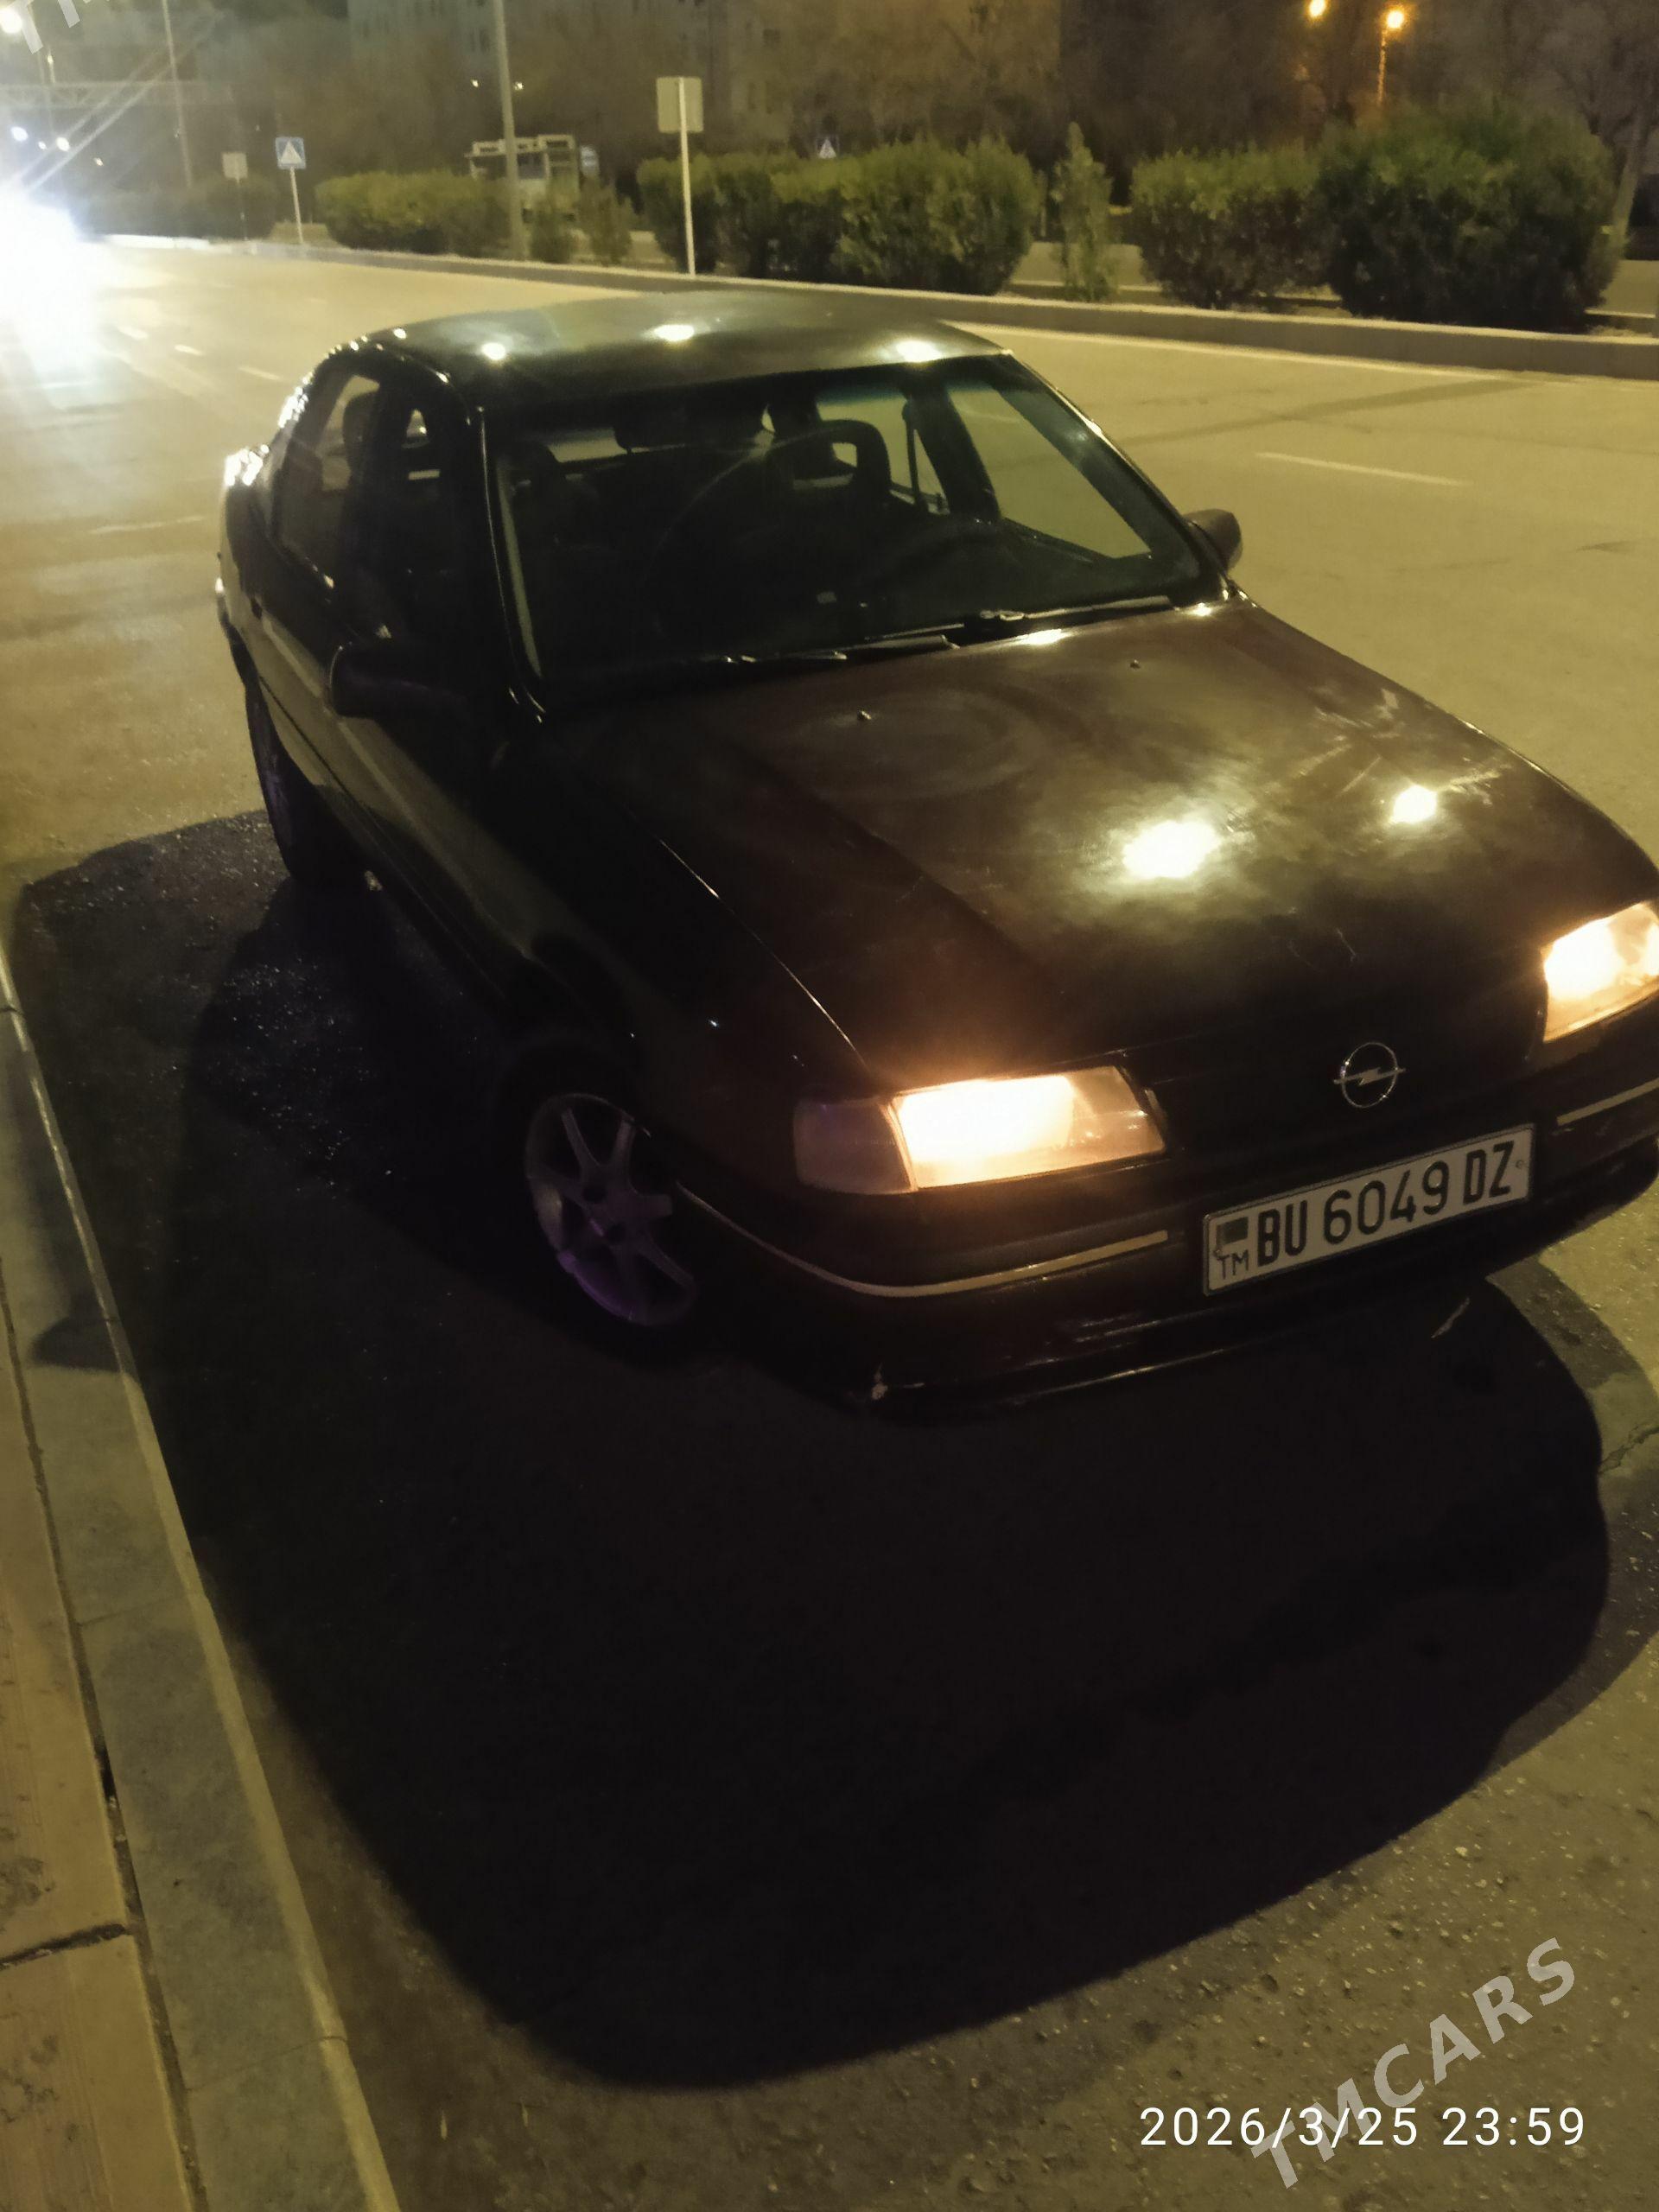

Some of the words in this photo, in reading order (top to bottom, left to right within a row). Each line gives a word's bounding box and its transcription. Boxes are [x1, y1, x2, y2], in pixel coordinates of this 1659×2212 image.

[1217, 1249, 1250, 1280] TM
[1257, 1199, 1308, 1267] BU
[1324, 1160, 1450, 1244] 6049
[1463, 1141, 1515, 1205] DZ
